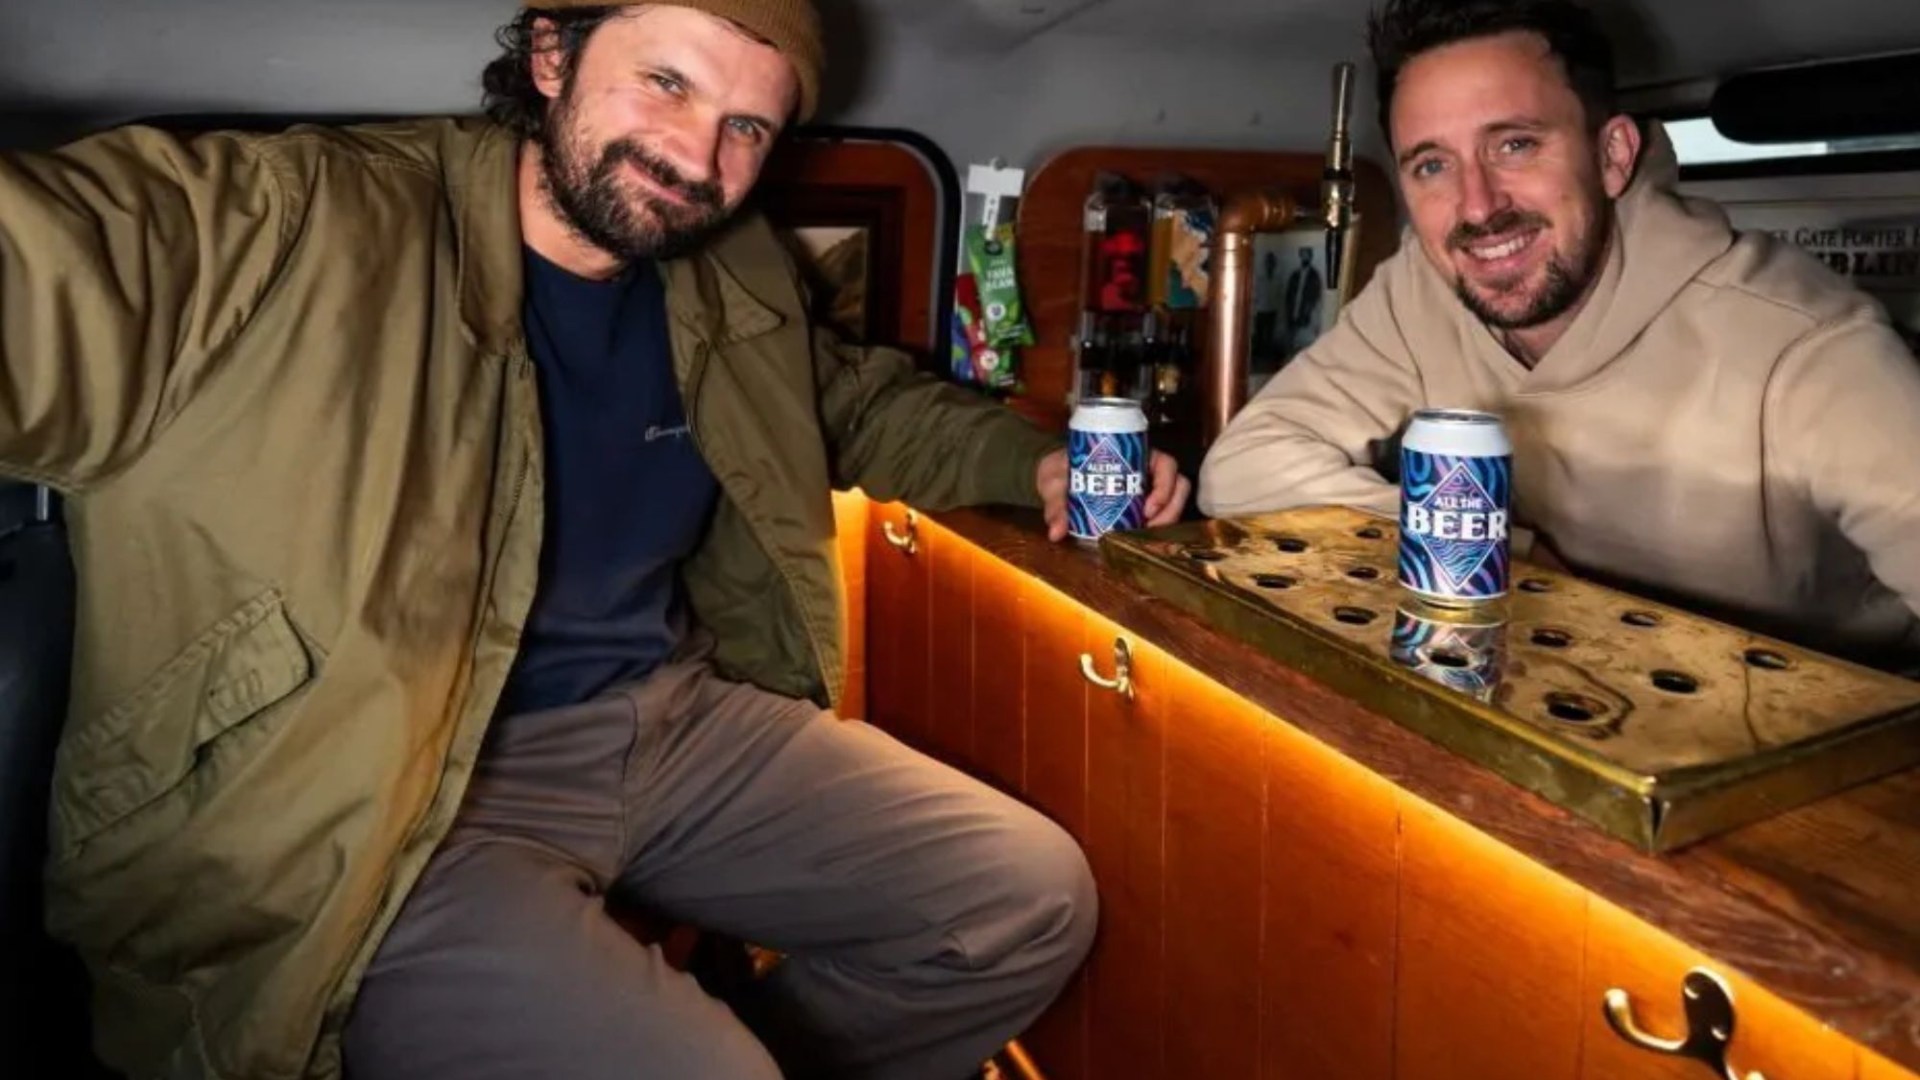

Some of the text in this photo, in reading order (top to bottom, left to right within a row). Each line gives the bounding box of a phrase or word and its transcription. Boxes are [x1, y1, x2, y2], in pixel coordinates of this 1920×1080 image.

[1795, 226, 1837, 247] GATE
[1842, 227, 1906, 248] PORTER
[1816, 252, 1919, 276] BLIN
[1070, 468, 1144, 496] BEER
[1434, 497, 1482, 509] ALL THE
[1406, 501, 1508, 540] BEER
